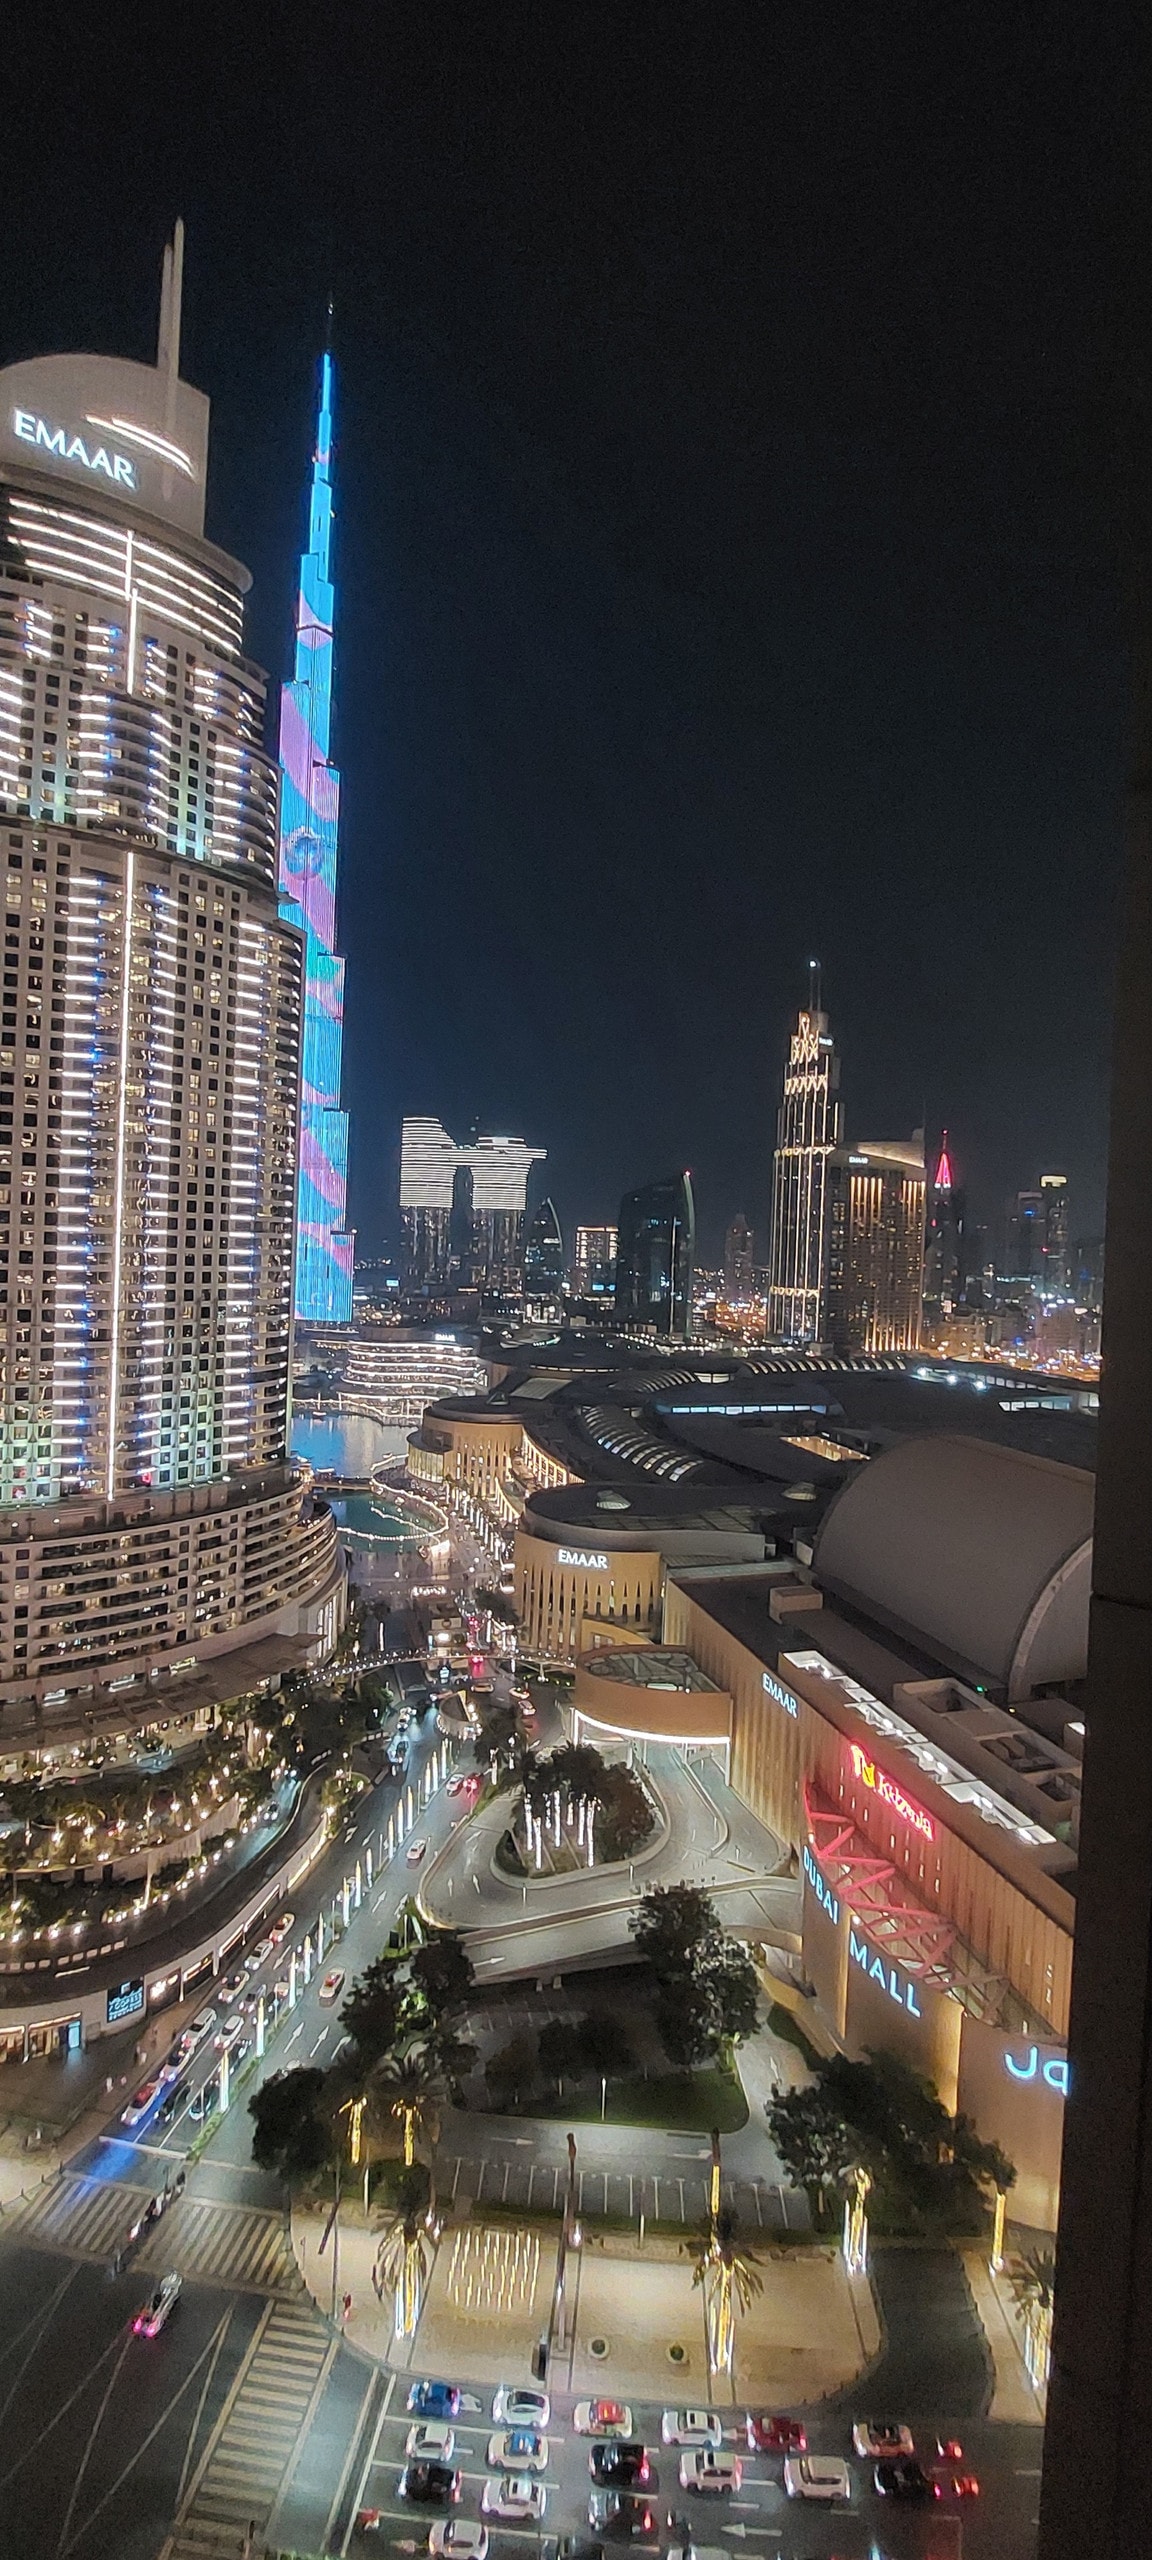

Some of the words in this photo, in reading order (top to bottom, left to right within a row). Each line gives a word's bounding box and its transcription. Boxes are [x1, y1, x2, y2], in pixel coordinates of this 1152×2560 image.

[14, 408, 136, 488] EMAAR
[557, 1549, 608, 1569] EMAAR
[762, 1672, 798, 1719] EMAAR
[803, 1845, 839, 1925] DUBAI
[850, 1930, 921, 2018] MALL
